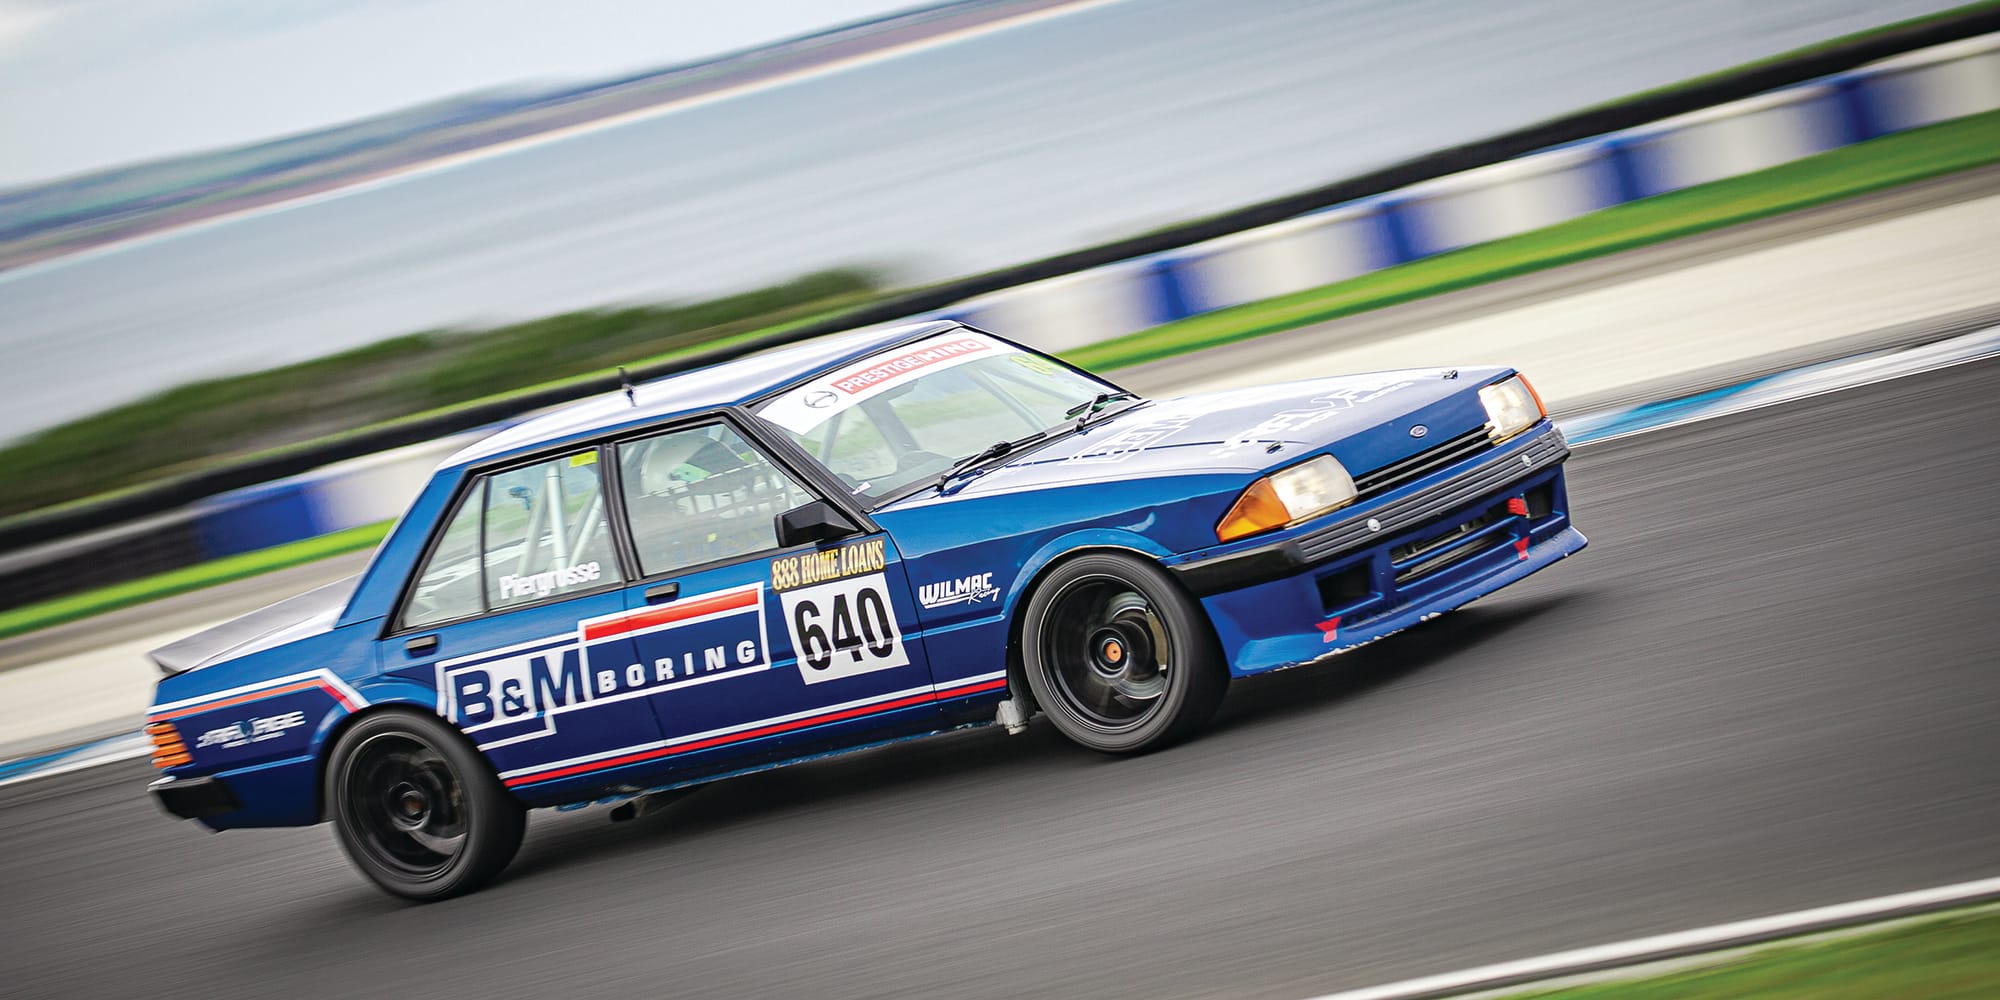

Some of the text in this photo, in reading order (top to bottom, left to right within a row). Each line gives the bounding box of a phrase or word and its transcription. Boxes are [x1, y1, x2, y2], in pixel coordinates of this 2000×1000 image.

[771, 540, 885, 591] 888 HOME LOANS
[919, 572, 993, 605] WILMAC
[795, 587, 894, 670] 640
[453, 639, 756, 723] B&M BORING
